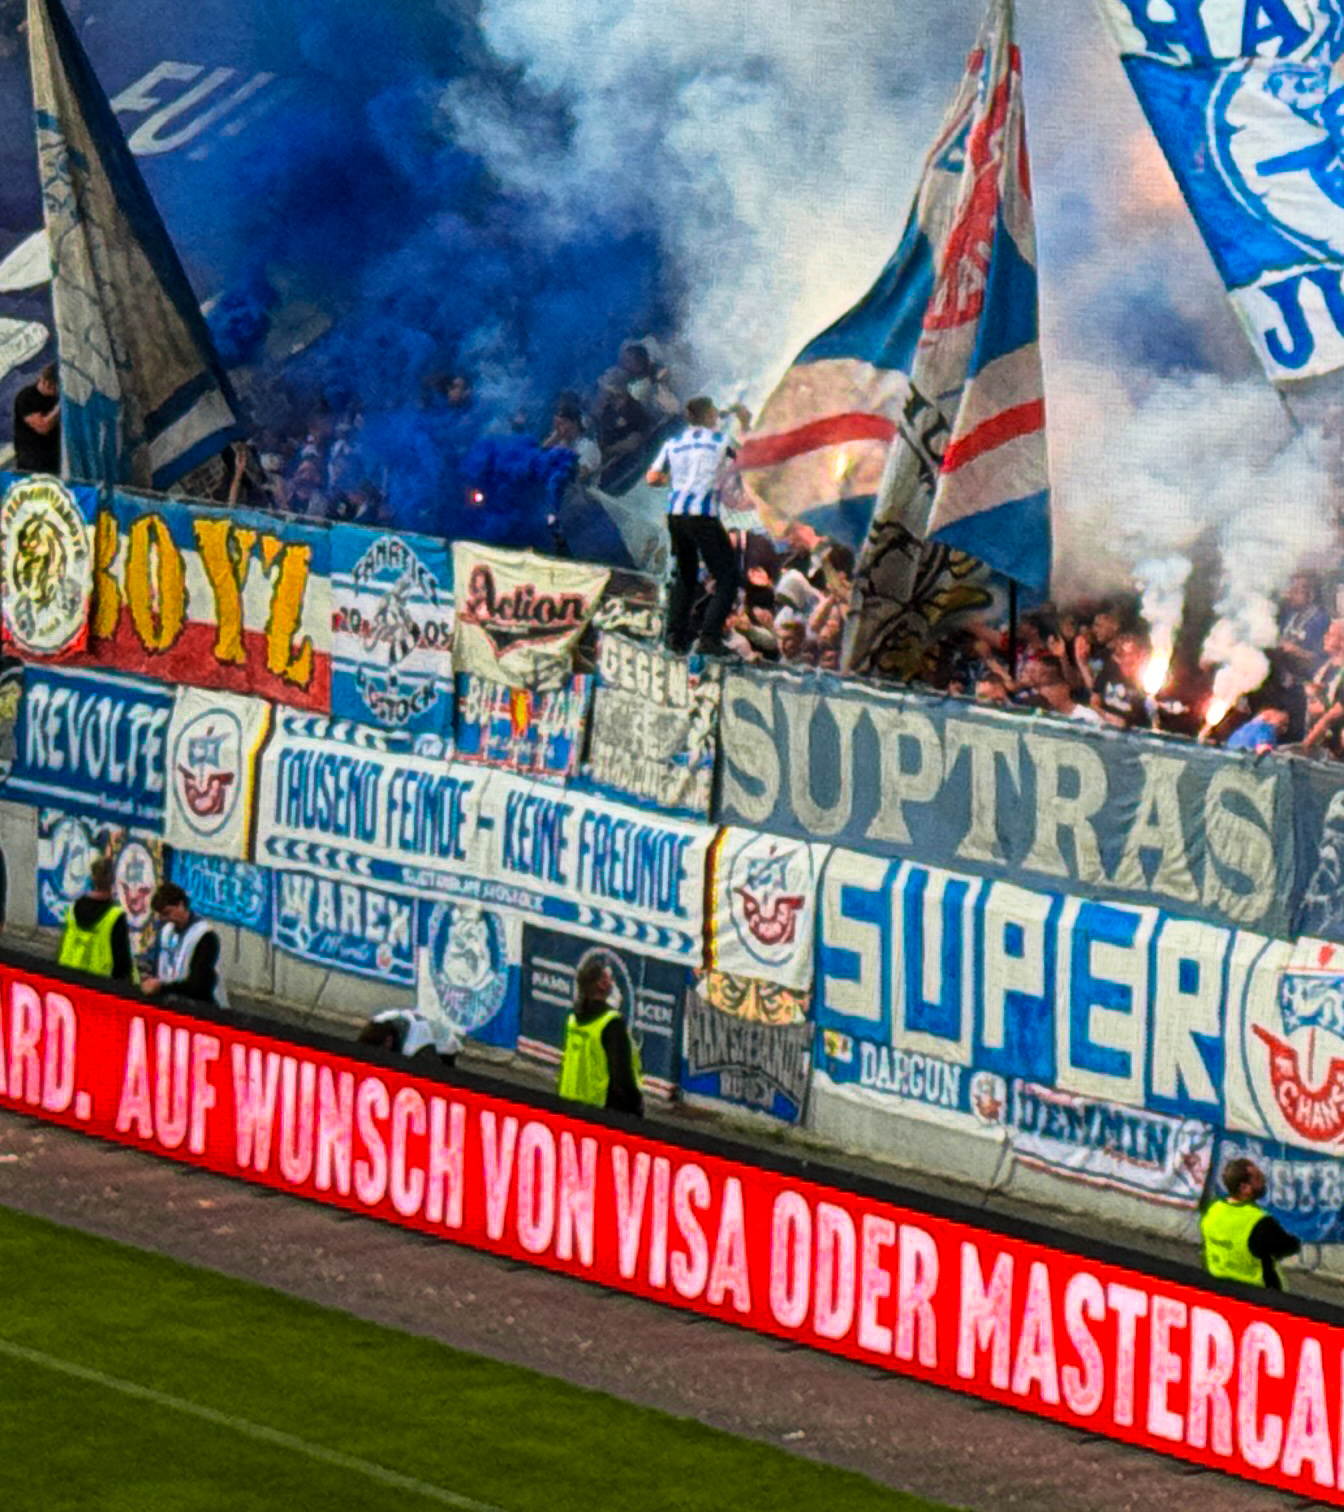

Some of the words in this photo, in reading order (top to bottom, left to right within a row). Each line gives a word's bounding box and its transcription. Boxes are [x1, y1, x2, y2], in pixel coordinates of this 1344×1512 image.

[463, 564, 585, 624] Action
[26, 682, 170, 794] REVOLTE
[275, 747, 385, 844] TAUSEND
[386, 767, 475, 862] FEINDE
[502, 789, 575, 886] KEINE
[576, 807, 697, 919] FREUNDE
[721, 673, 1278, 923] SUPTRAS
[820, 846, 1232, 1104] SUPER
[0, 981, 92, 1121] RD.
[115, 1016, 220, 1154] AUF
[231, 1043, 466, 1229] WUNSCH
[481, 1110, 598, 1266] VON
[612, 1145, 750, 1314] VISA
[769, 1189, 940, 1369] ODER
